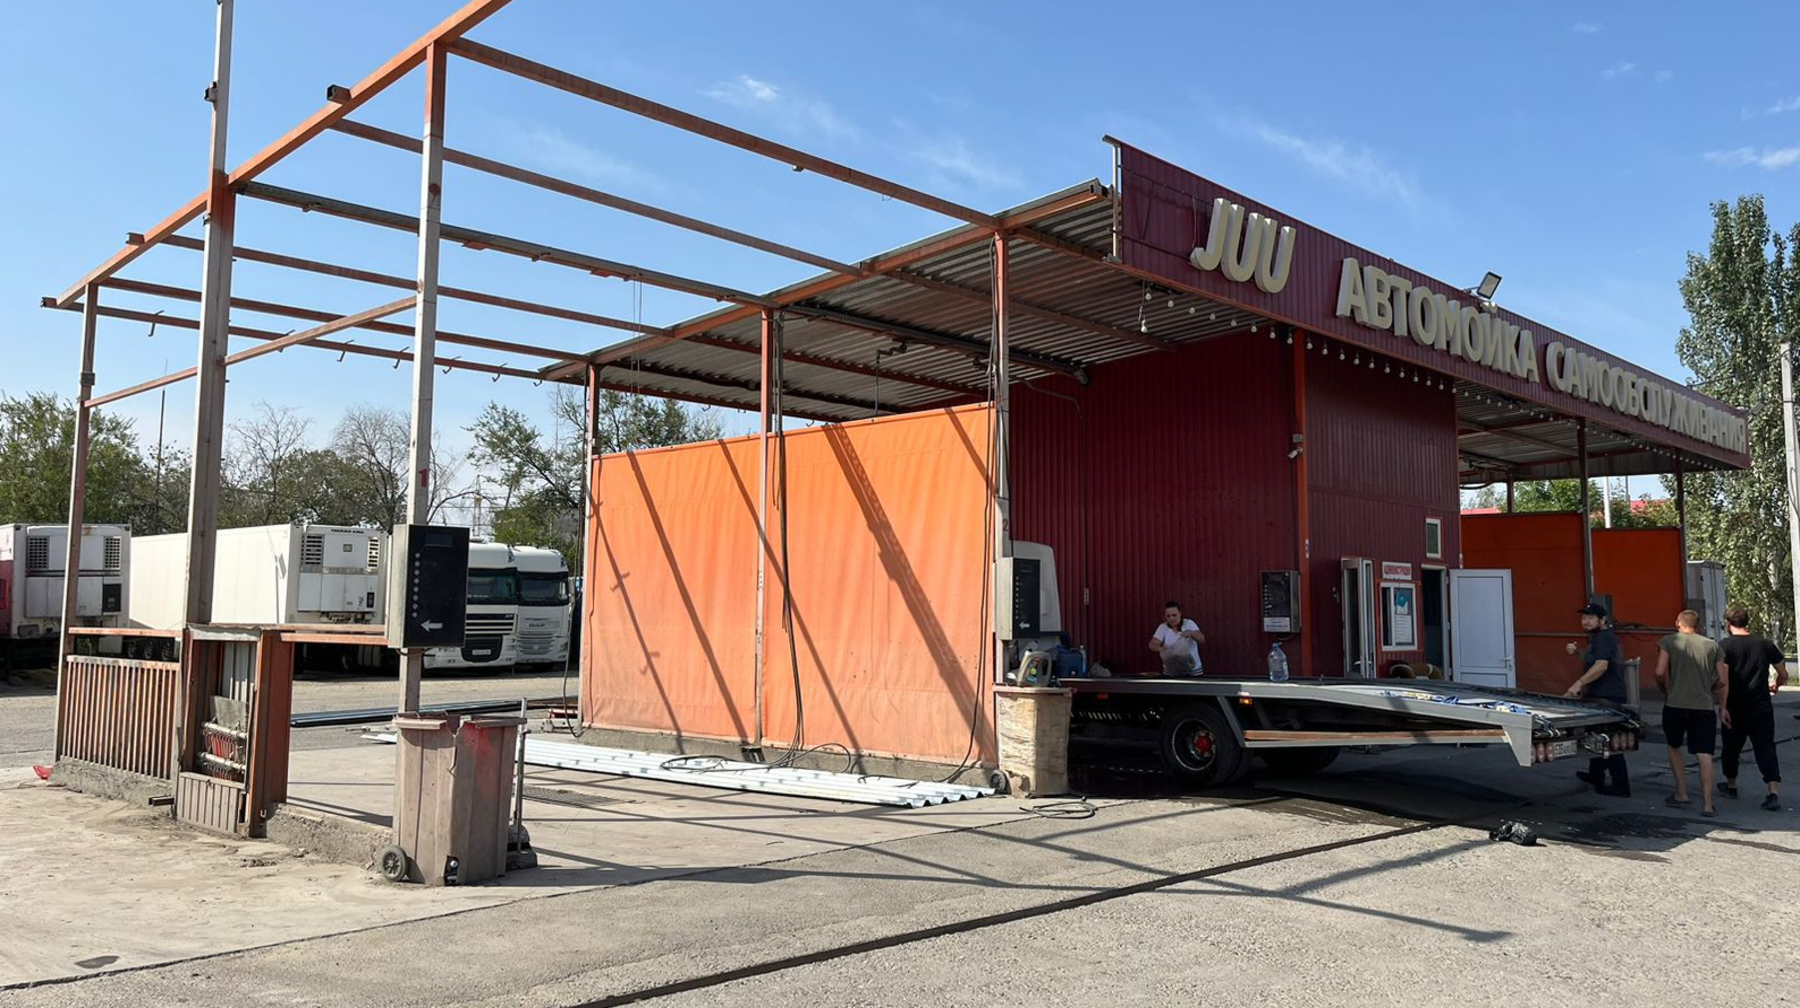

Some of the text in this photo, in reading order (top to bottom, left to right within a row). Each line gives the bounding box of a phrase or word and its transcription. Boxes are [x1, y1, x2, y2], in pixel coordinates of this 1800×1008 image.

[1190, 198, 1297, 294] JUU
[1336, 257, 1746, 455] АВТОМОЙКА САМООБСЛУЖИВАНИЯ
[419, 468, 429, 488] 1
[1002, 519, 1009, 532] 2
